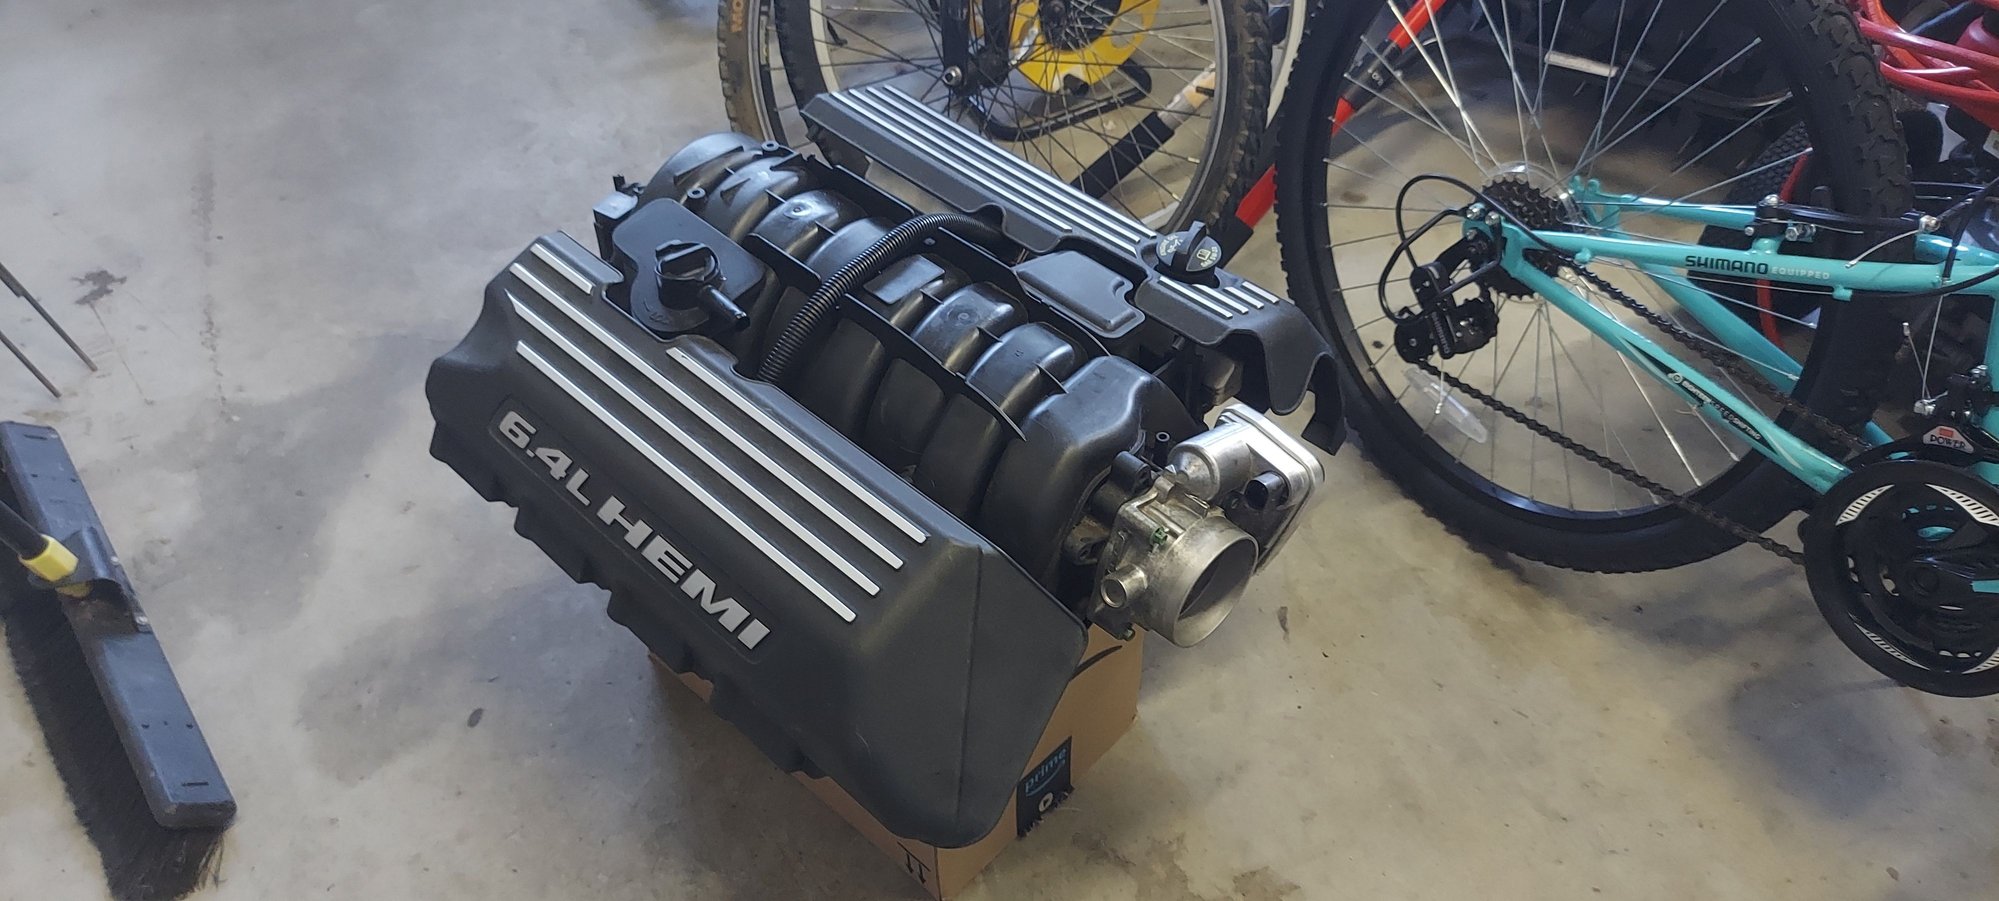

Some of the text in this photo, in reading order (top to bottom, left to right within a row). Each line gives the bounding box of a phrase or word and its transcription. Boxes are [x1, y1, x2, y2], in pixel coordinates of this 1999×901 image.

[1685, 255, 1830, 280] SHIMANO EQUIPPED
[1930, 434, 1967, 450] POWER
[499, 410, 771, 650] 6.4L HEMI
[1025, 747, 1067, 794] prime
